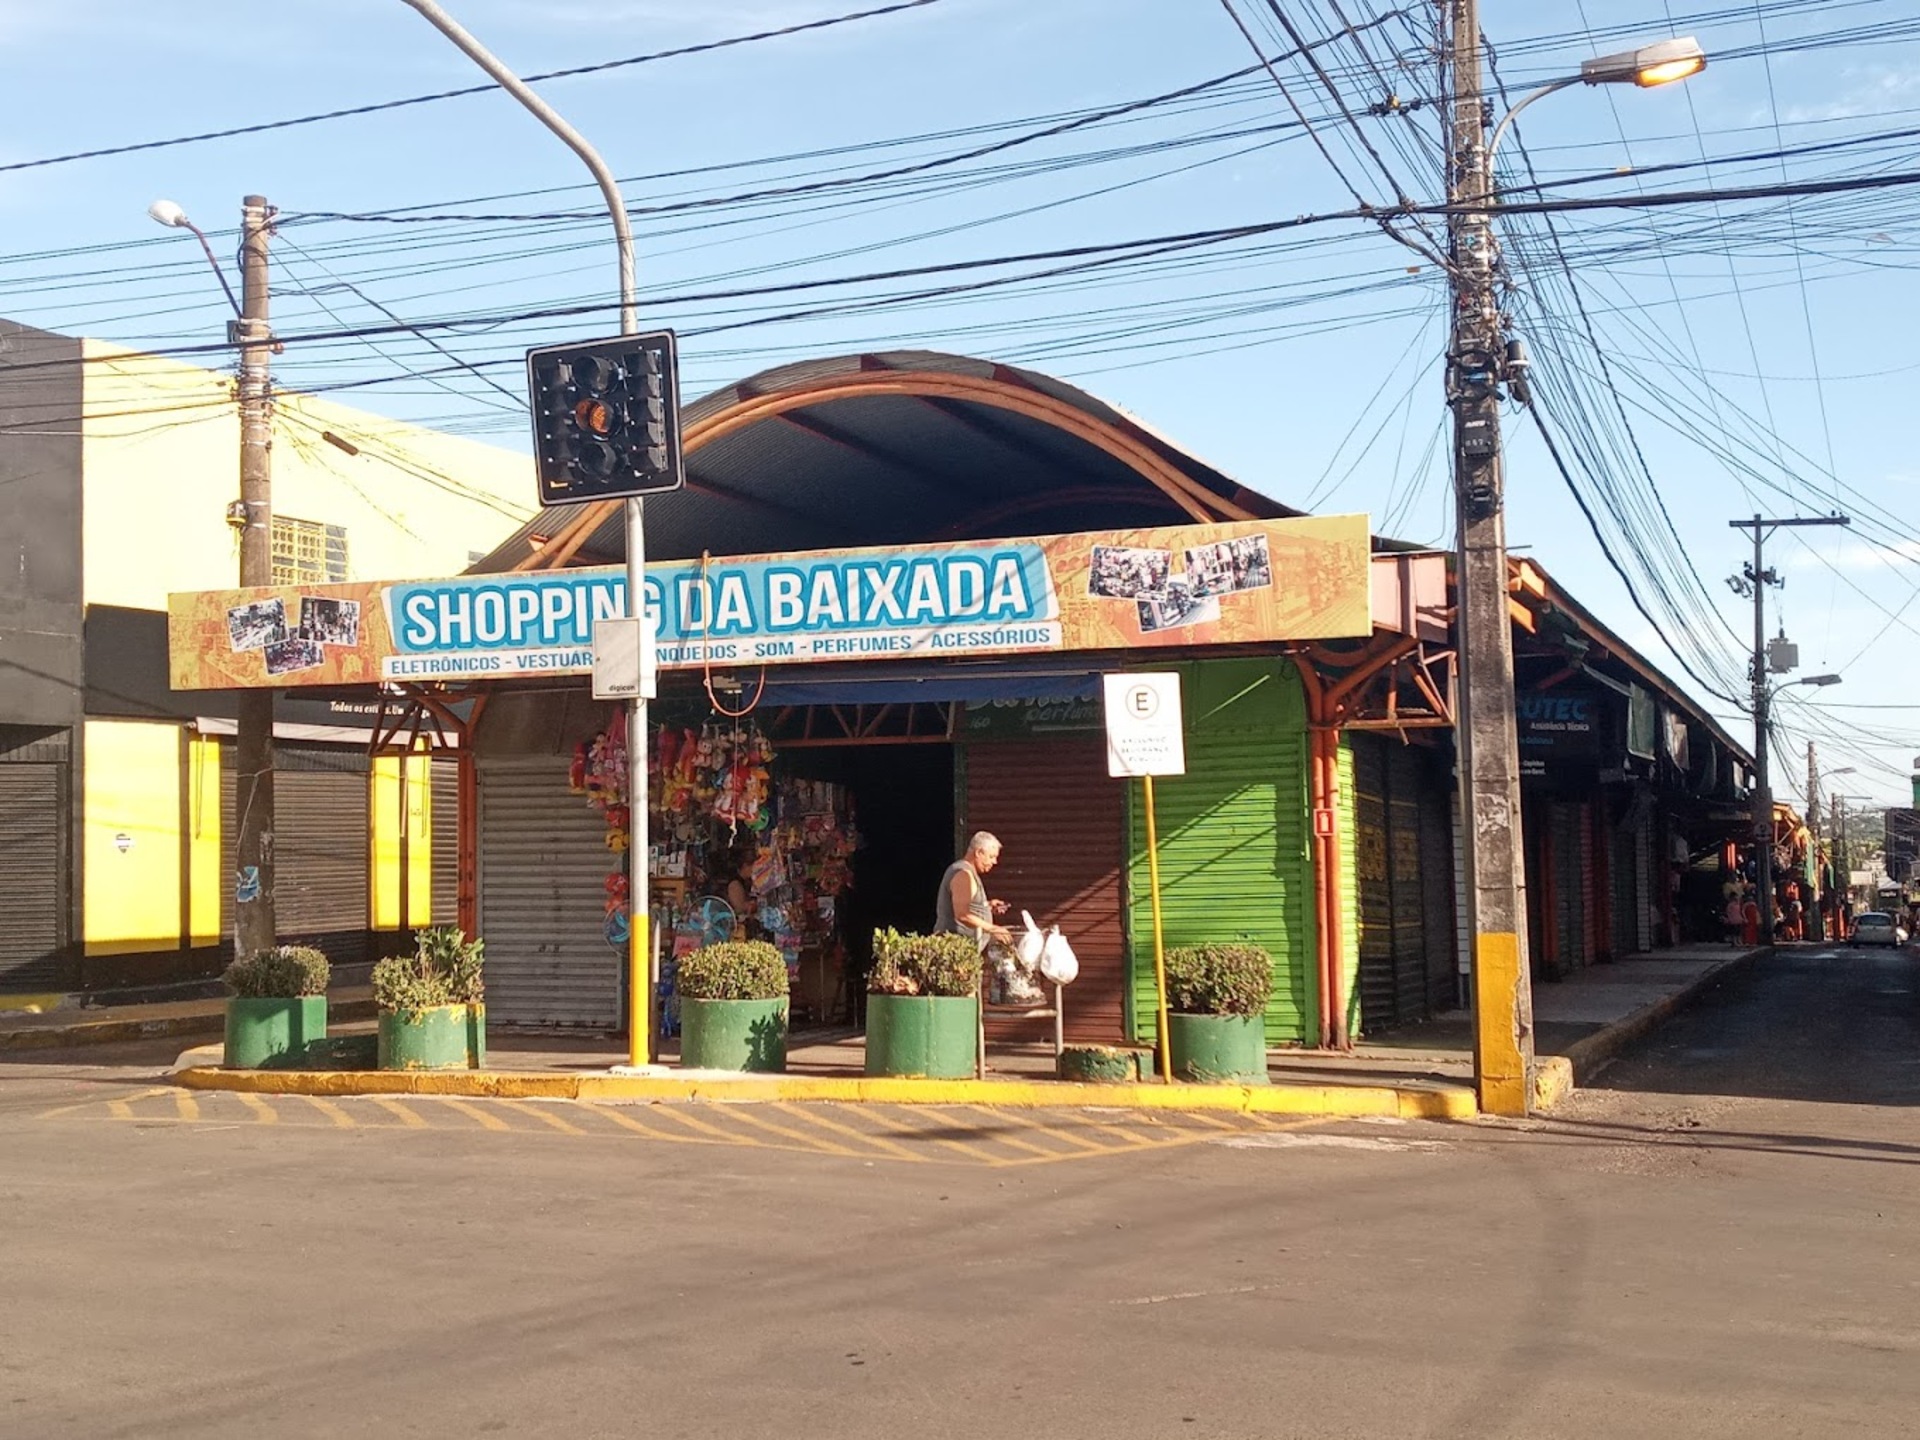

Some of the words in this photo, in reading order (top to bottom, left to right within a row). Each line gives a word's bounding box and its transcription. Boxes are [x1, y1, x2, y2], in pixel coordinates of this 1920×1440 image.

[679, 575, 753, 632] DA
[768, 557, 1030, 628] BAIXADA
[391, 655, 500, 674] ELETRÔNICOS
[517, 650, 593, 669] VESTUÁR
[755, 641, 795, 657] SOM
[813, 635, 912, 654] PERFUMES
[931, 626, 1050, 648] ACESSÓRIOS
[609, 684, 636, 693] digicon
[1136, 692, 1149, 711] E
